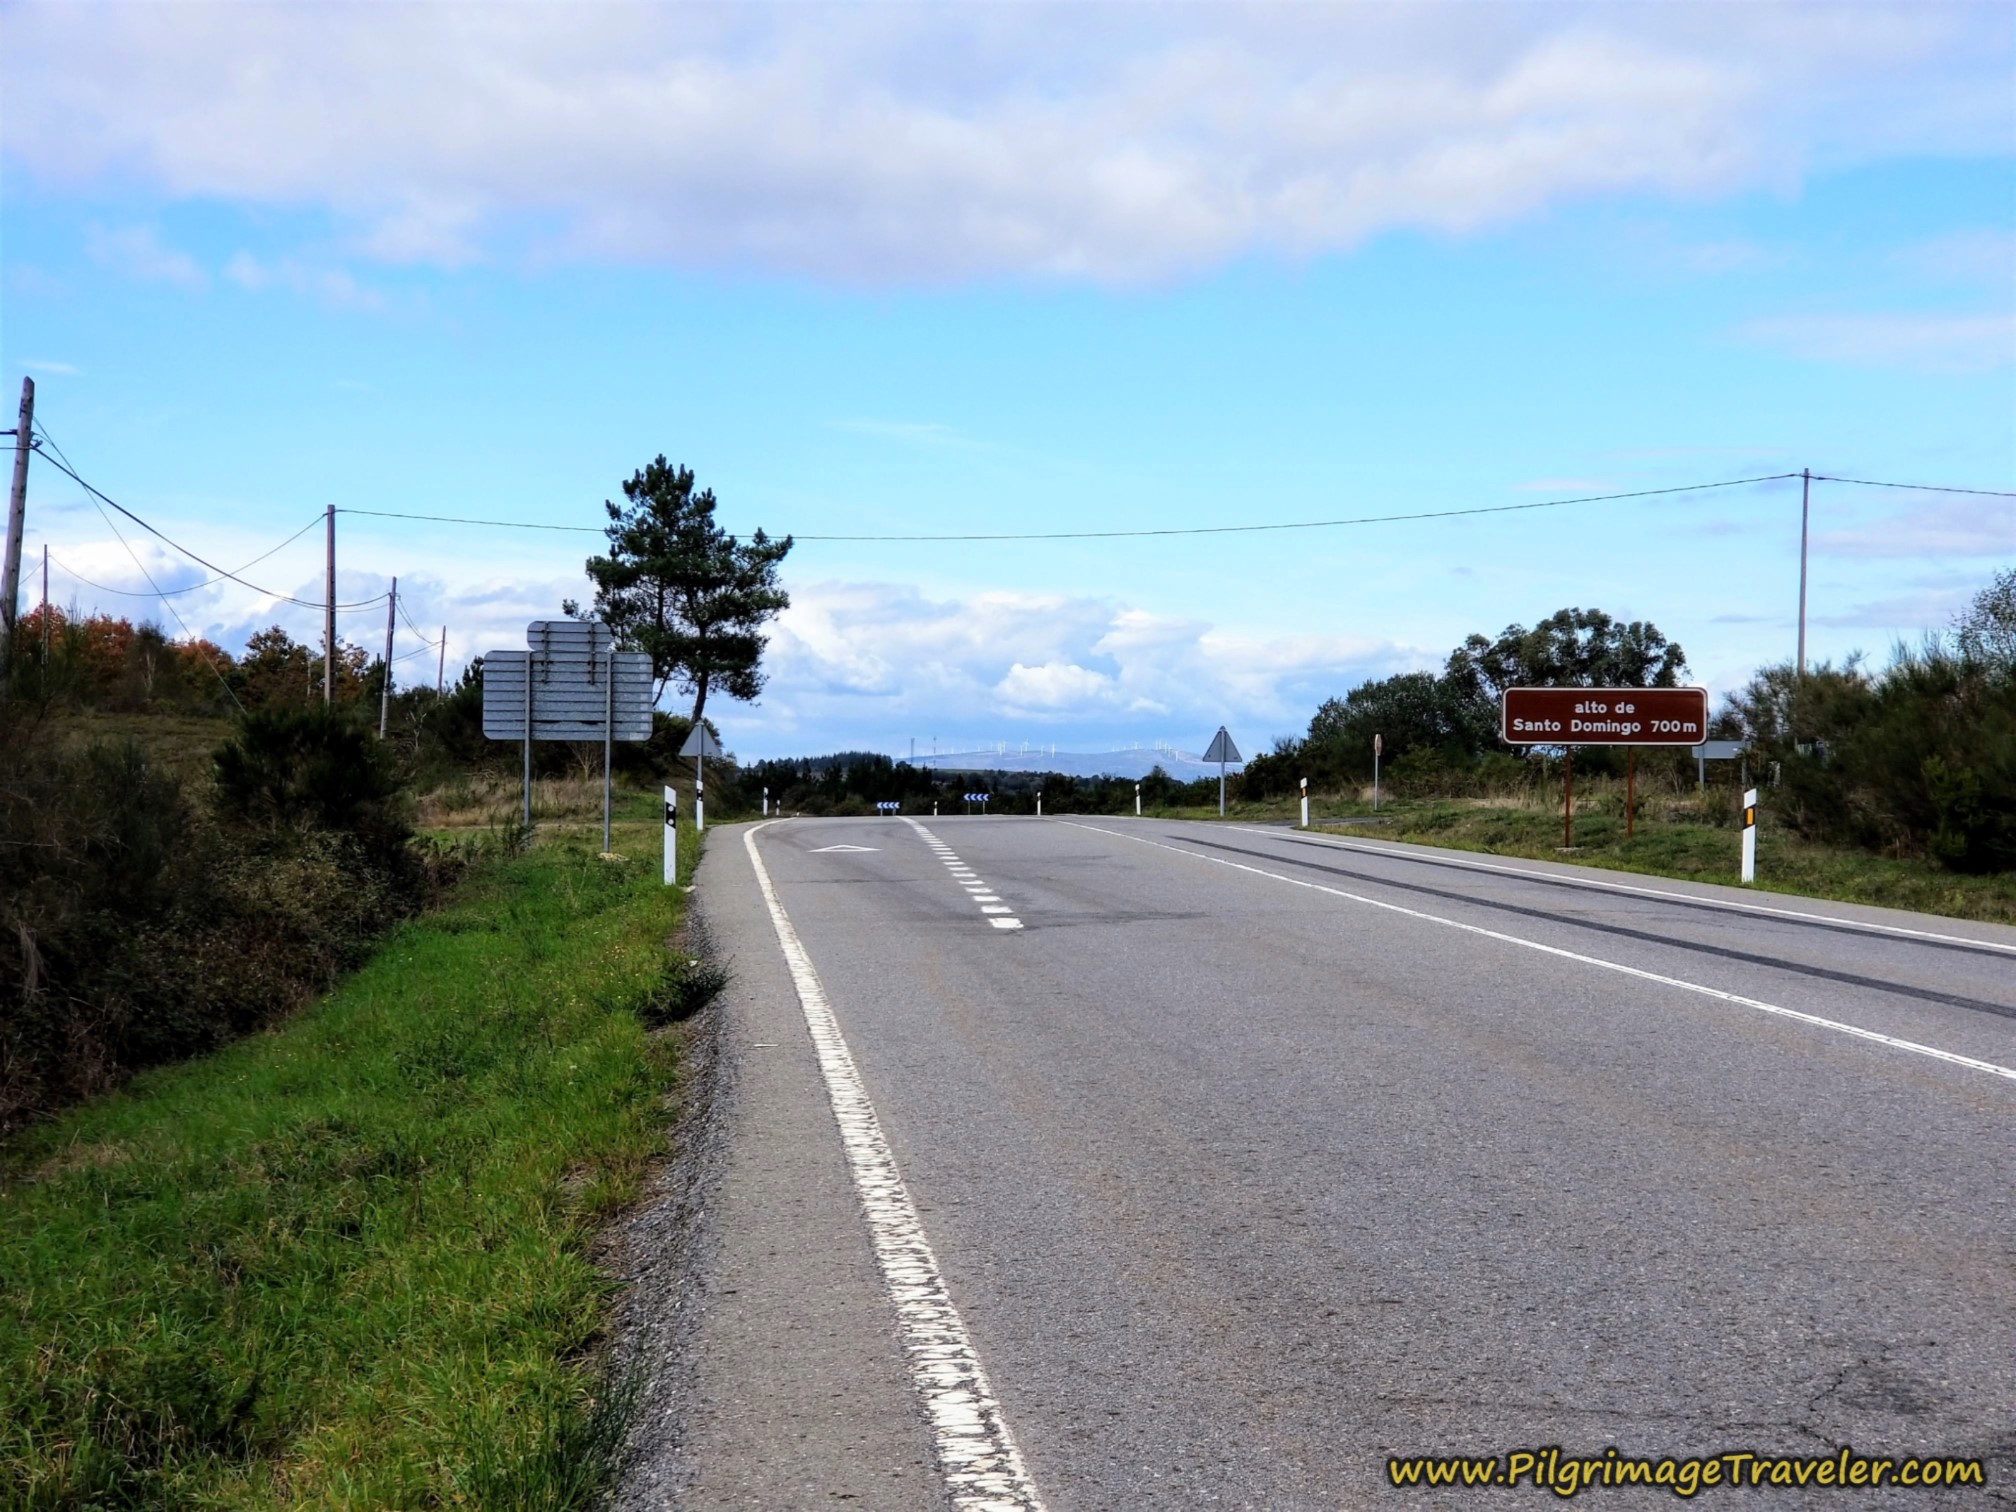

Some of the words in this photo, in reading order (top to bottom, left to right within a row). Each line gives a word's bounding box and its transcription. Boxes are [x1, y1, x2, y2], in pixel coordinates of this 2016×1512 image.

[1575, 701, 1607, 713] alto
[1615, 701, 1635, 713] de
[1513, 719, 1561, 731] Santo
[1571, 719, 1641, 735] Domingo
